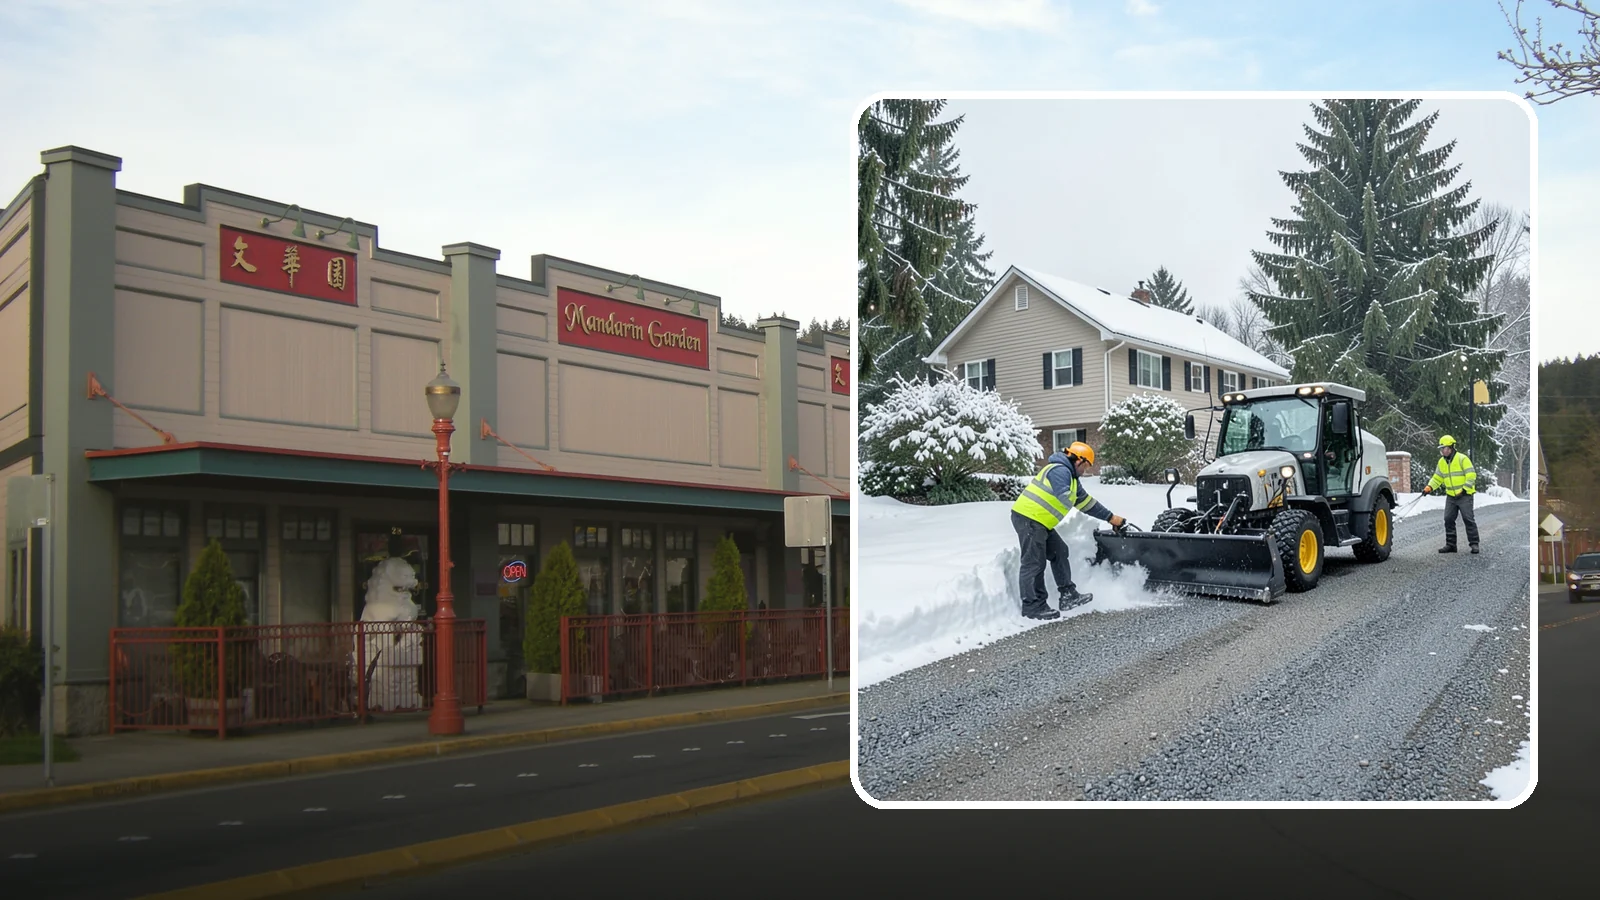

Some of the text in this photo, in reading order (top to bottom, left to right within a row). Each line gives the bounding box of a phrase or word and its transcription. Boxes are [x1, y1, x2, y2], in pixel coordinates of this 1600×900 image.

[231, 235, 346, 291] 文華園
[565, 302, 701, 352] Mandarin Garden
[503, 565, 527, 578] OPEN
